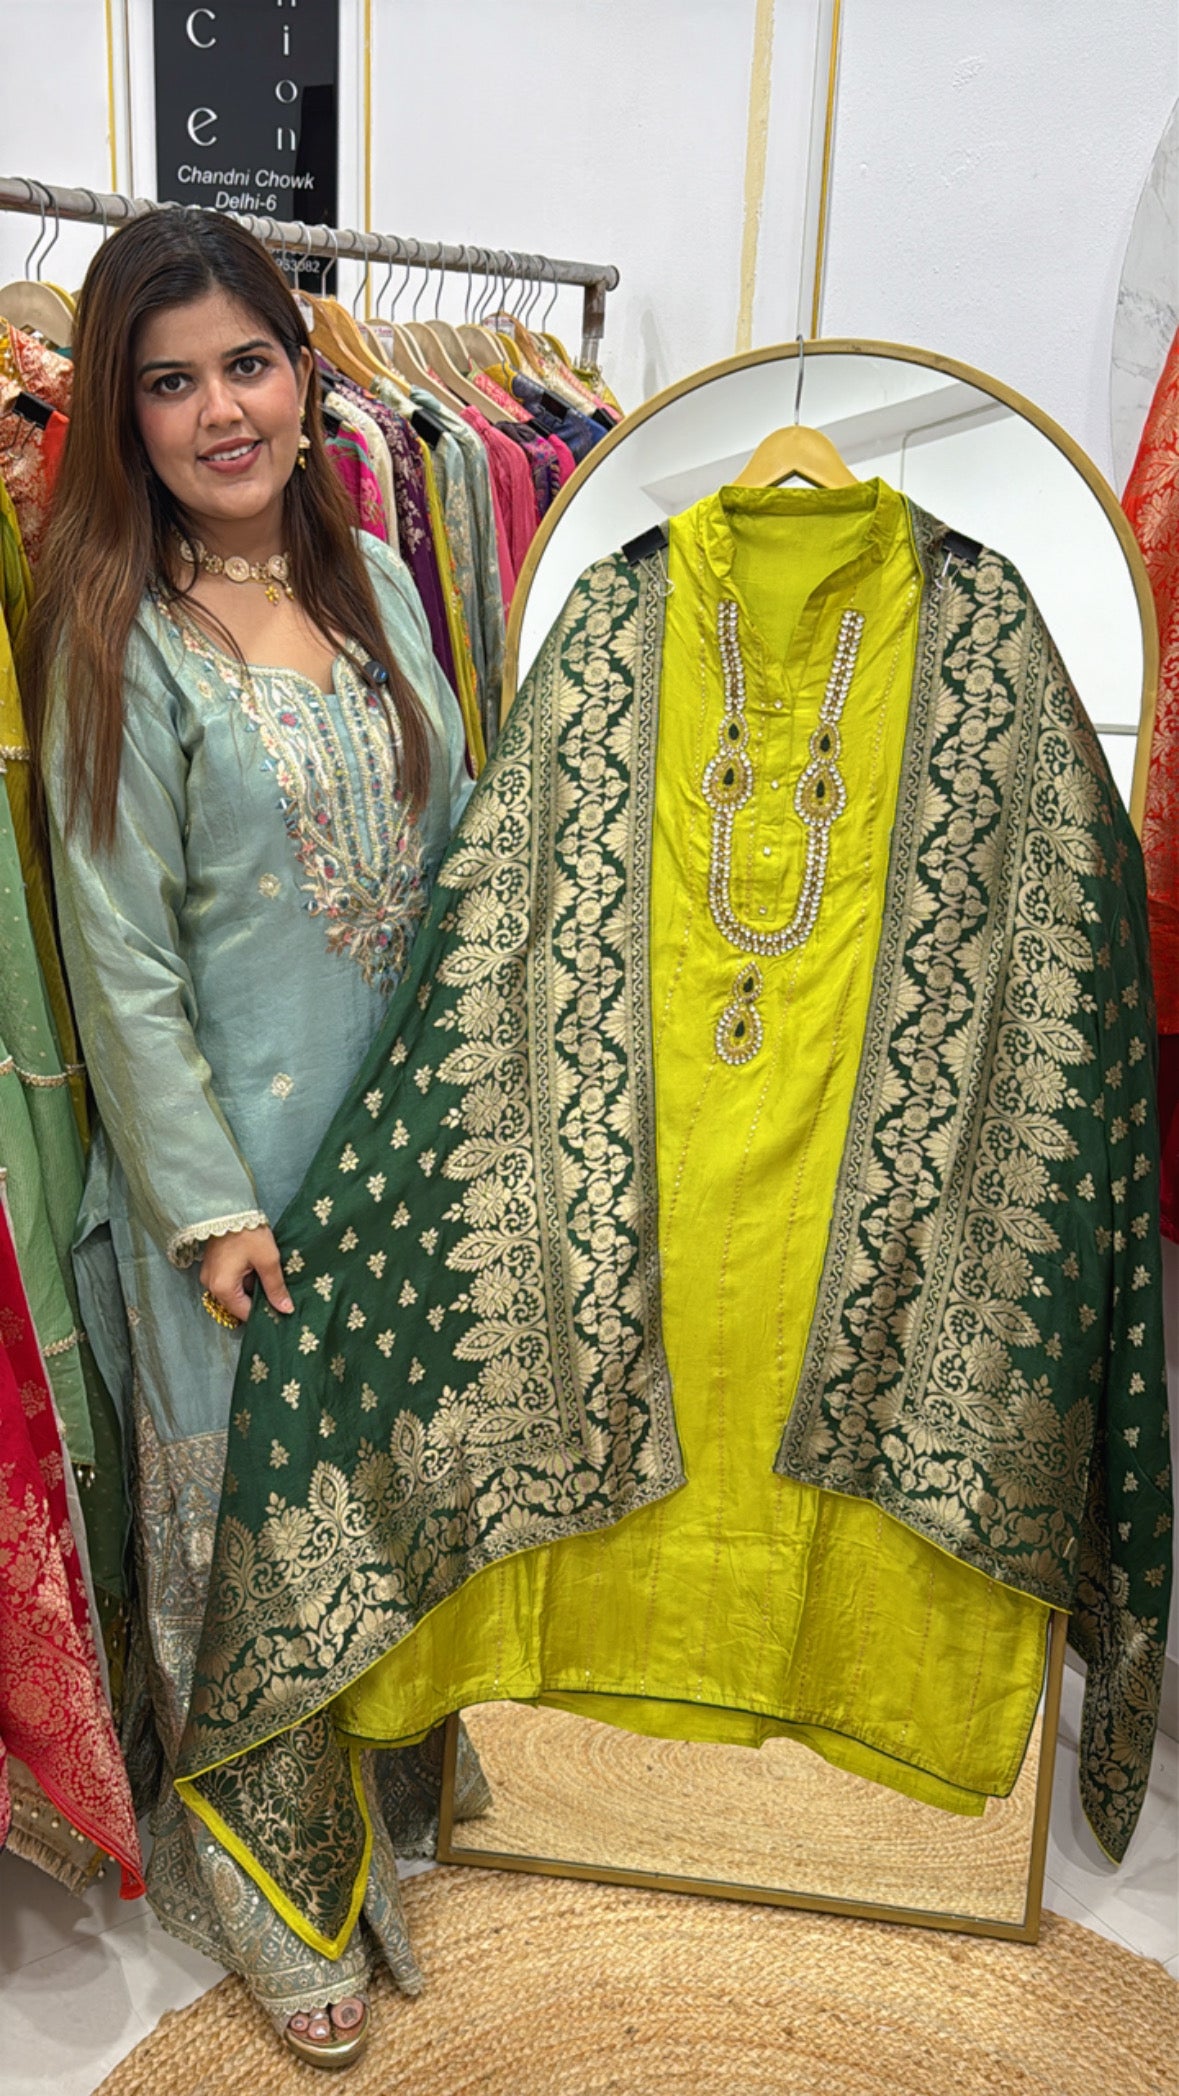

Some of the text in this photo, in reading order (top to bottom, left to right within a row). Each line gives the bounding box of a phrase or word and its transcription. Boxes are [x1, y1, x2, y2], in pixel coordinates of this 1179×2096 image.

[177, 165, 315, 190] Chandni Chowk
[215, 191, 278, 212] Delhi-6
